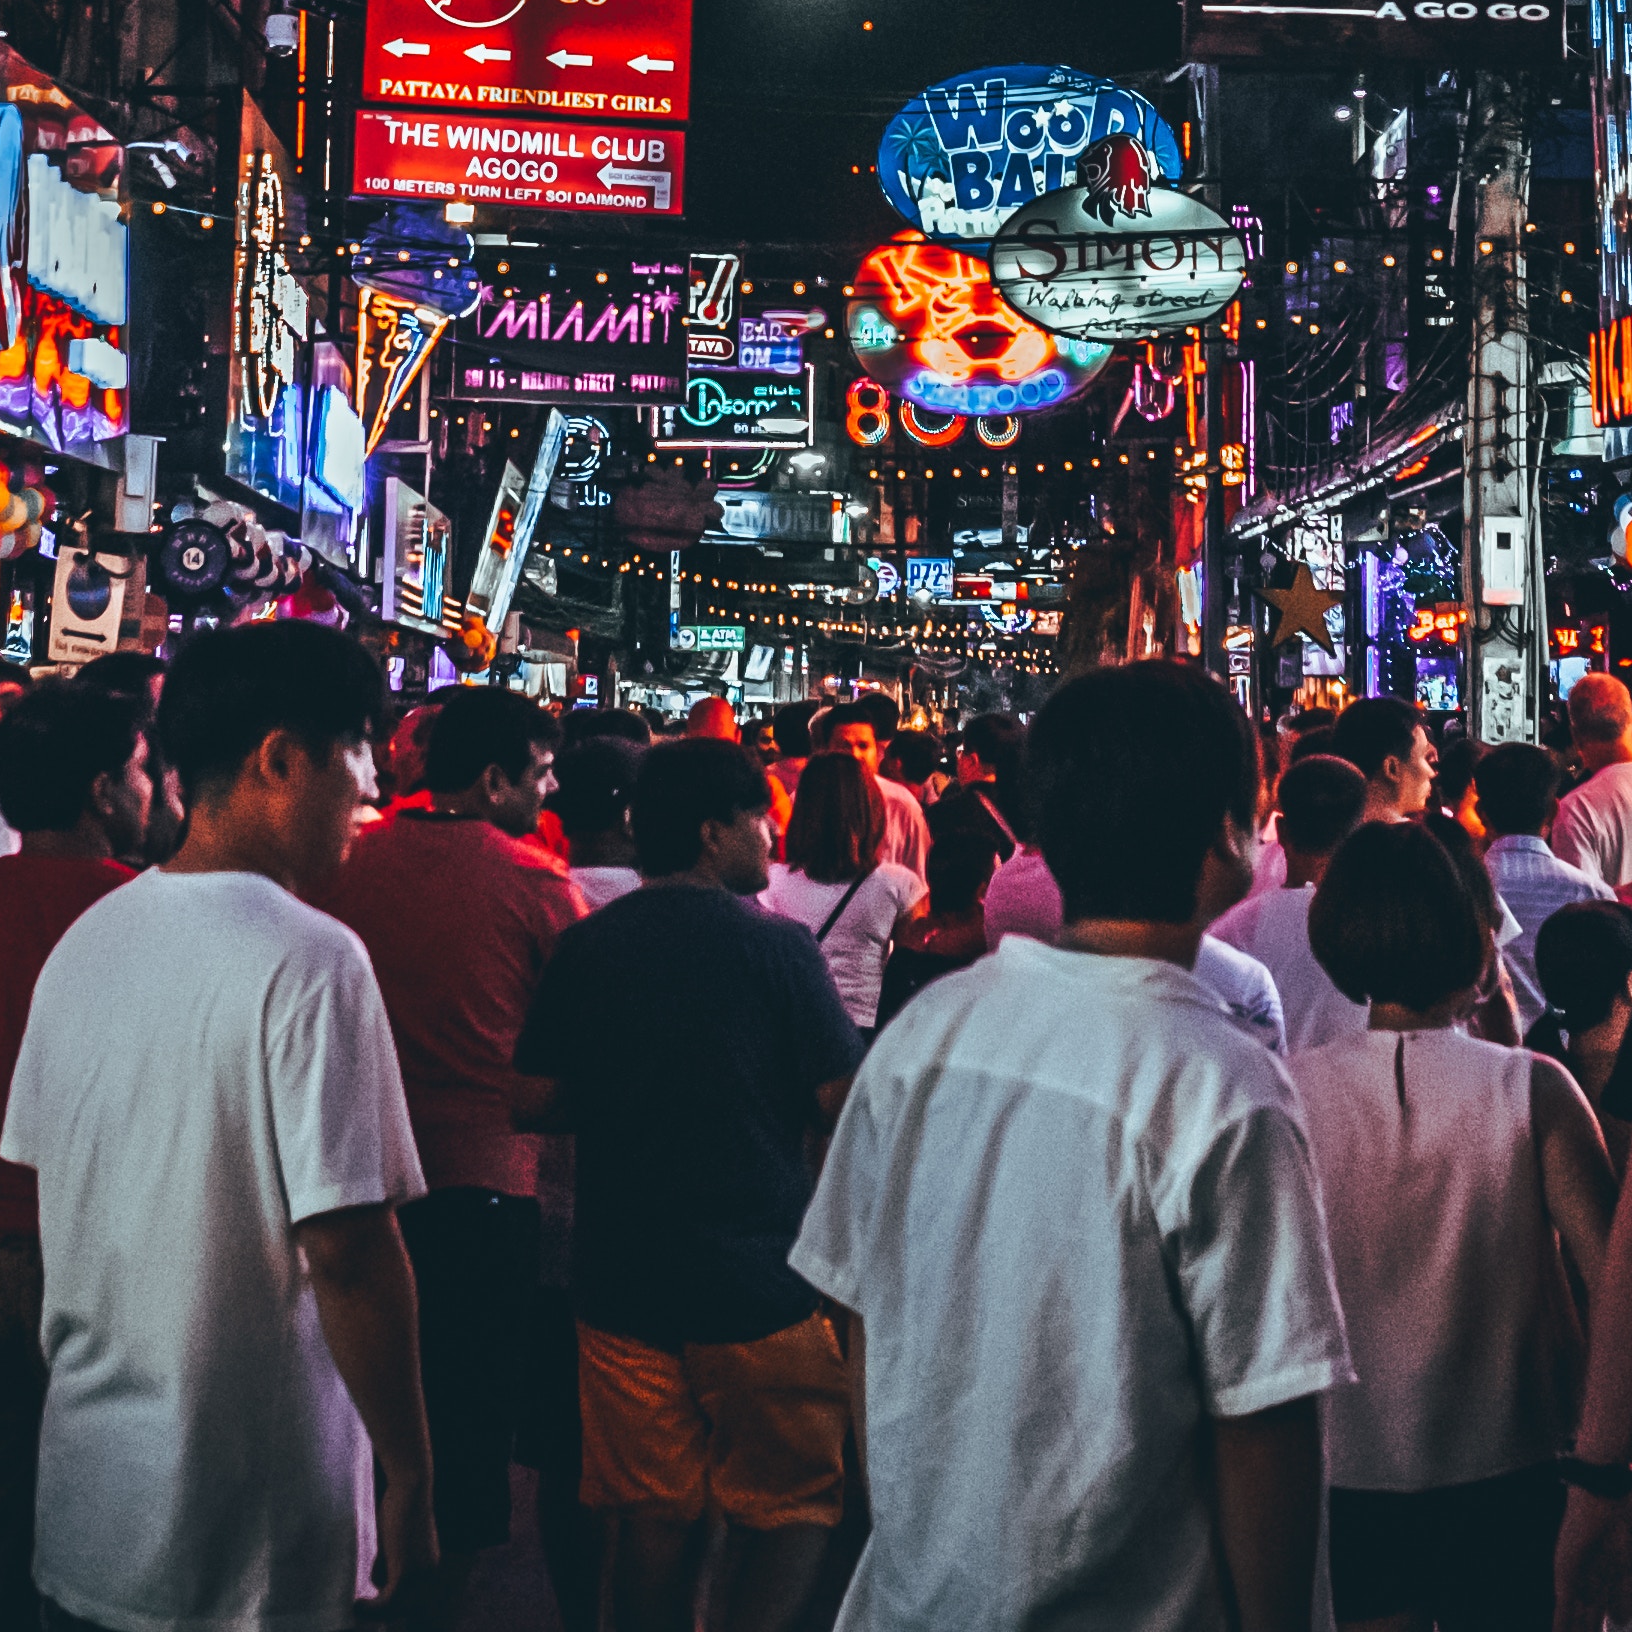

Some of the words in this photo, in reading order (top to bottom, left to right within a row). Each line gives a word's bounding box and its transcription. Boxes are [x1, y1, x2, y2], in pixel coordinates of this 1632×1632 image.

[1374, 1, 1407, 21] A
[1413, 1, 1478, 20] GO
[1486, 2, 1550, 21] GO
[380, 78, 473, 102] PATTAYA
[477, 85, 608, 110] FRIENDLIEST
[611, 94, 672, 114] GIRLS
[385, 120, 440, 147] THE
[446, 124, 585, 159] WINDMILL
[591, 135, 666, 163] CLUB
[466, 155, 558, 184] AGOGO
[365, 177, 390, 191] 100
[393, 178, 456, 198] METERS
[460, 182, 502, 199] TURN
[505, 184, 542, 202] LEFT
[545, 190, 572, 204] SOI
[575, 191, 647, 209] DAIMOND
[1016, 219, 1225, 282] SIMON
[1026, 284, 1122, 313] Walking
[1134, 288, 1216, 307] street
